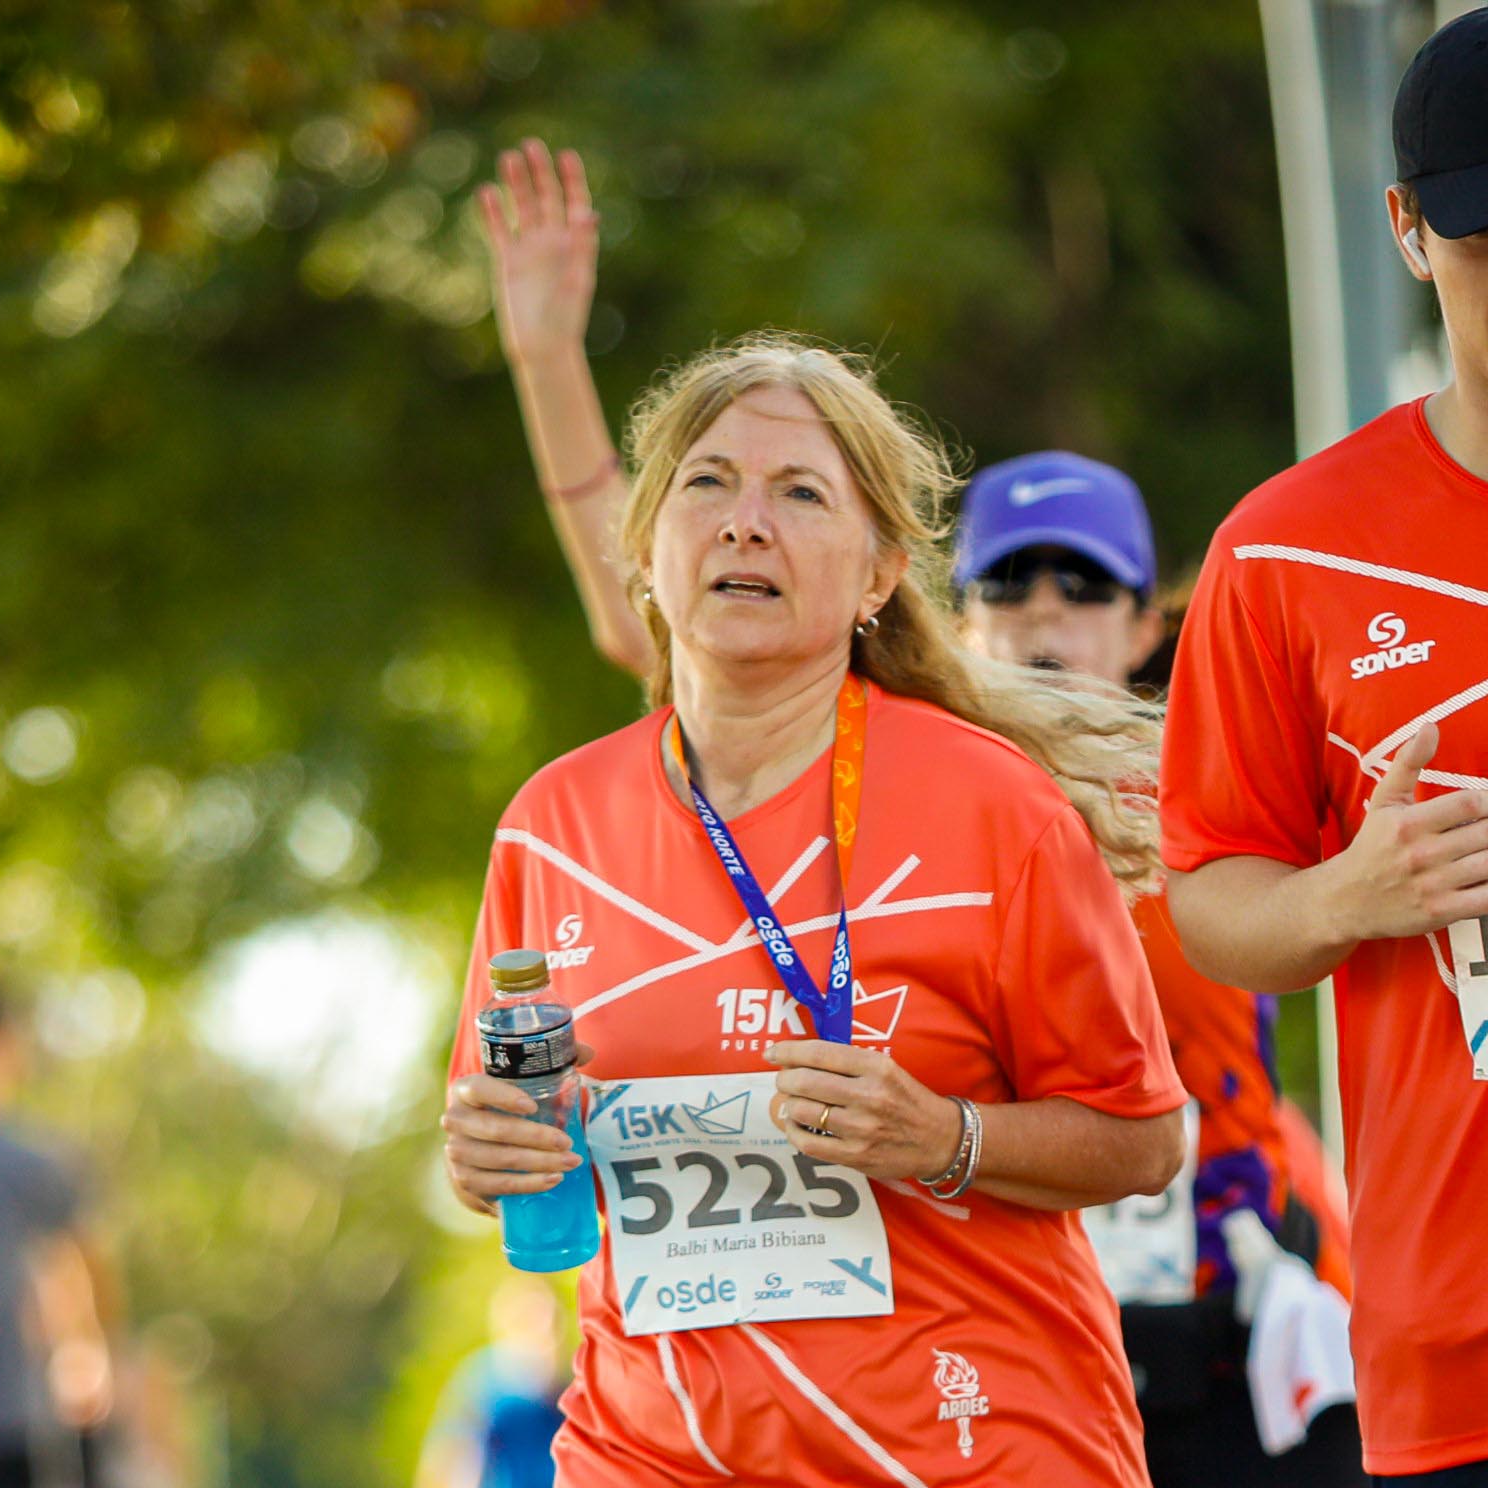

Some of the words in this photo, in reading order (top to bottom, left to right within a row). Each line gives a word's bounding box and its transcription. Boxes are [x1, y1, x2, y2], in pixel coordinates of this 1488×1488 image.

[707, 827, 746, 875] NORTE
[757, 916, 794, 966] osde
[832, 930, 850, 989] osde
[717, 988, 807, 1035] 15K
[612, 1104, 686, 1140] 15K
[610, 1151, 861, 1235] 5225
[667, 1239, 707, 1258] Balbi
[712, 1234, 757, 1252] Maria
[762, 1230, 826, 1248] Bibiana
[657, 1273, 737, 1313] osde
[938, 1396, 990, 1421] ARDEC
